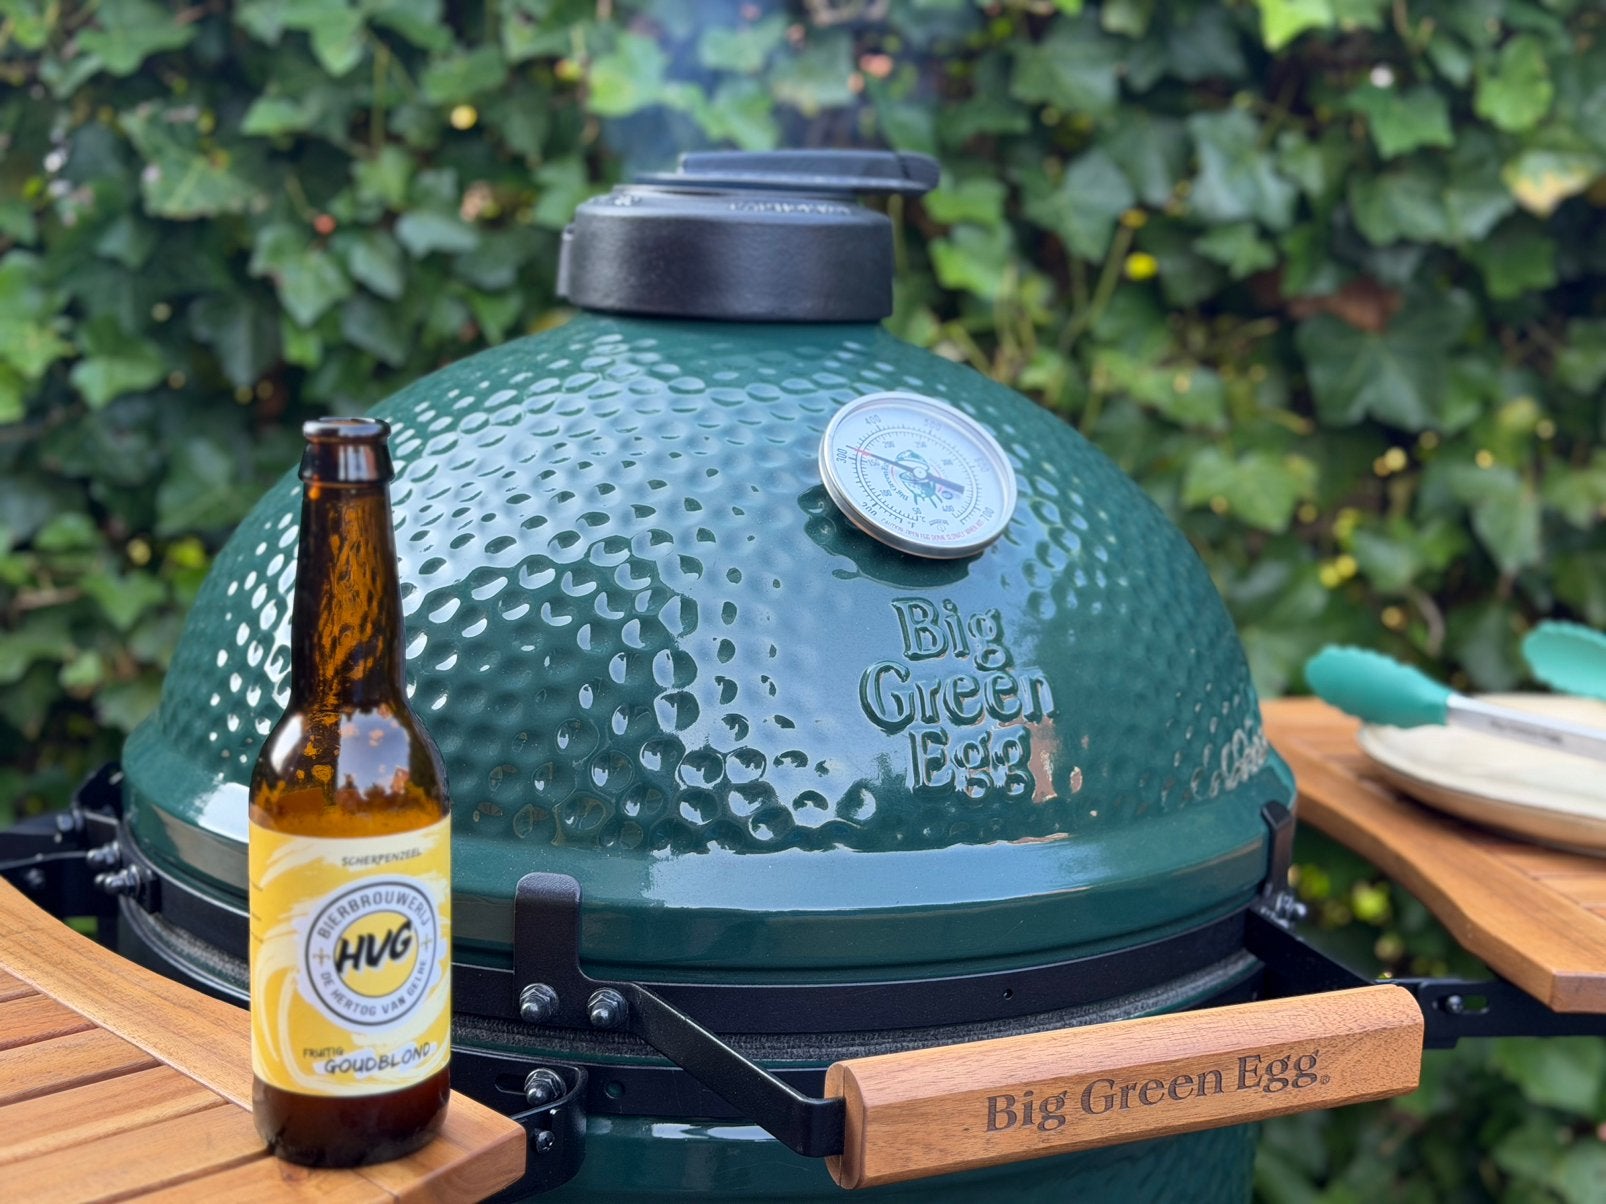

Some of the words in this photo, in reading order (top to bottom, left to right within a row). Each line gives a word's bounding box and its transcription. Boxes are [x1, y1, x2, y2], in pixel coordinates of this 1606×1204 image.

[836, 448, 848, 463] 300
[893, 598, 1013, 671] Big
[860, 658, 1056, 734] Green
[908, 724, 1034, 799] Egg
[341, 847, 422, 867] SCHERPENZEEL
[317, 891, 431, 939] BIERBROUWERIJ
[336, 916, 412, 974] HVG
[331, 989, 377, 1017] HERTOG
[381, 996, 406, 1015] VAN
[324, 1042, 431, 1075] GOUDBLOND
[985, 1089, 1068, 1132] Big
[1080, 1069, 1224, 1116] Green
